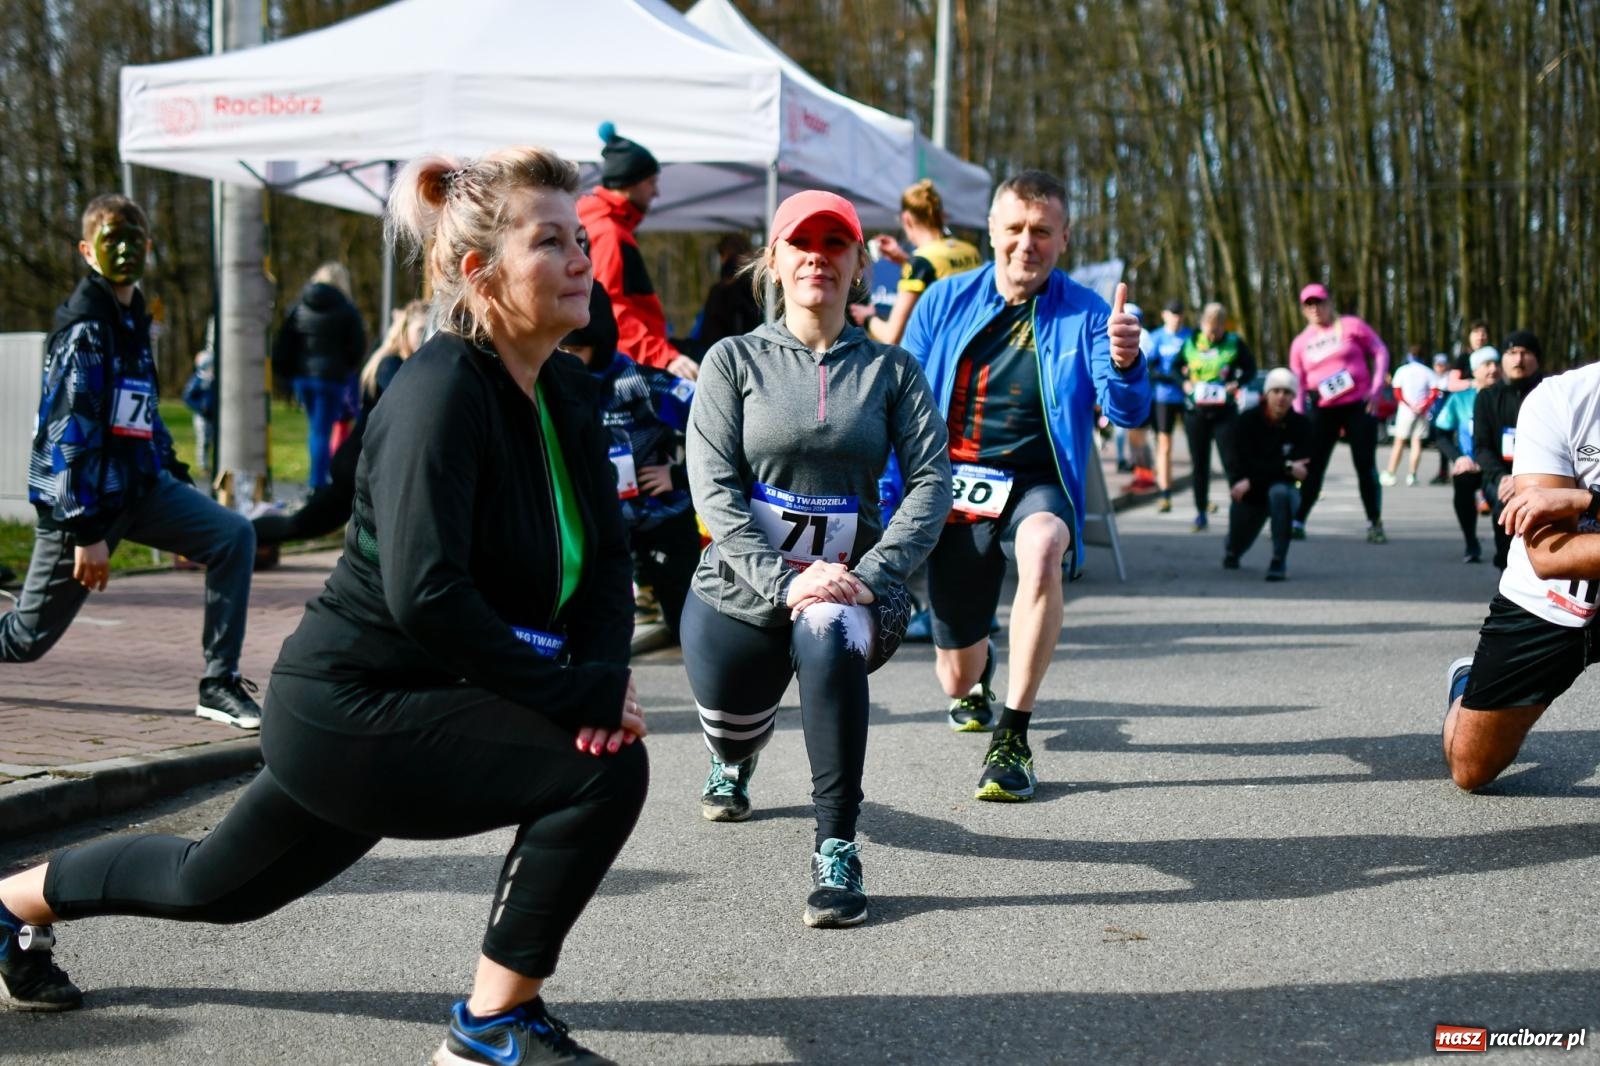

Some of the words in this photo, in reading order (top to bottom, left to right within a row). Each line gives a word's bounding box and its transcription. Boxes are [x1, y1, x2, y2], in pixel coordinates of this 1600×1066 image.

[766, 487, 777, 497] XII
[777, 490, 796, 503] BIEG
[796, 496, 848, 506] TWARDZIELA
[780, 511, 828, 556] 71
